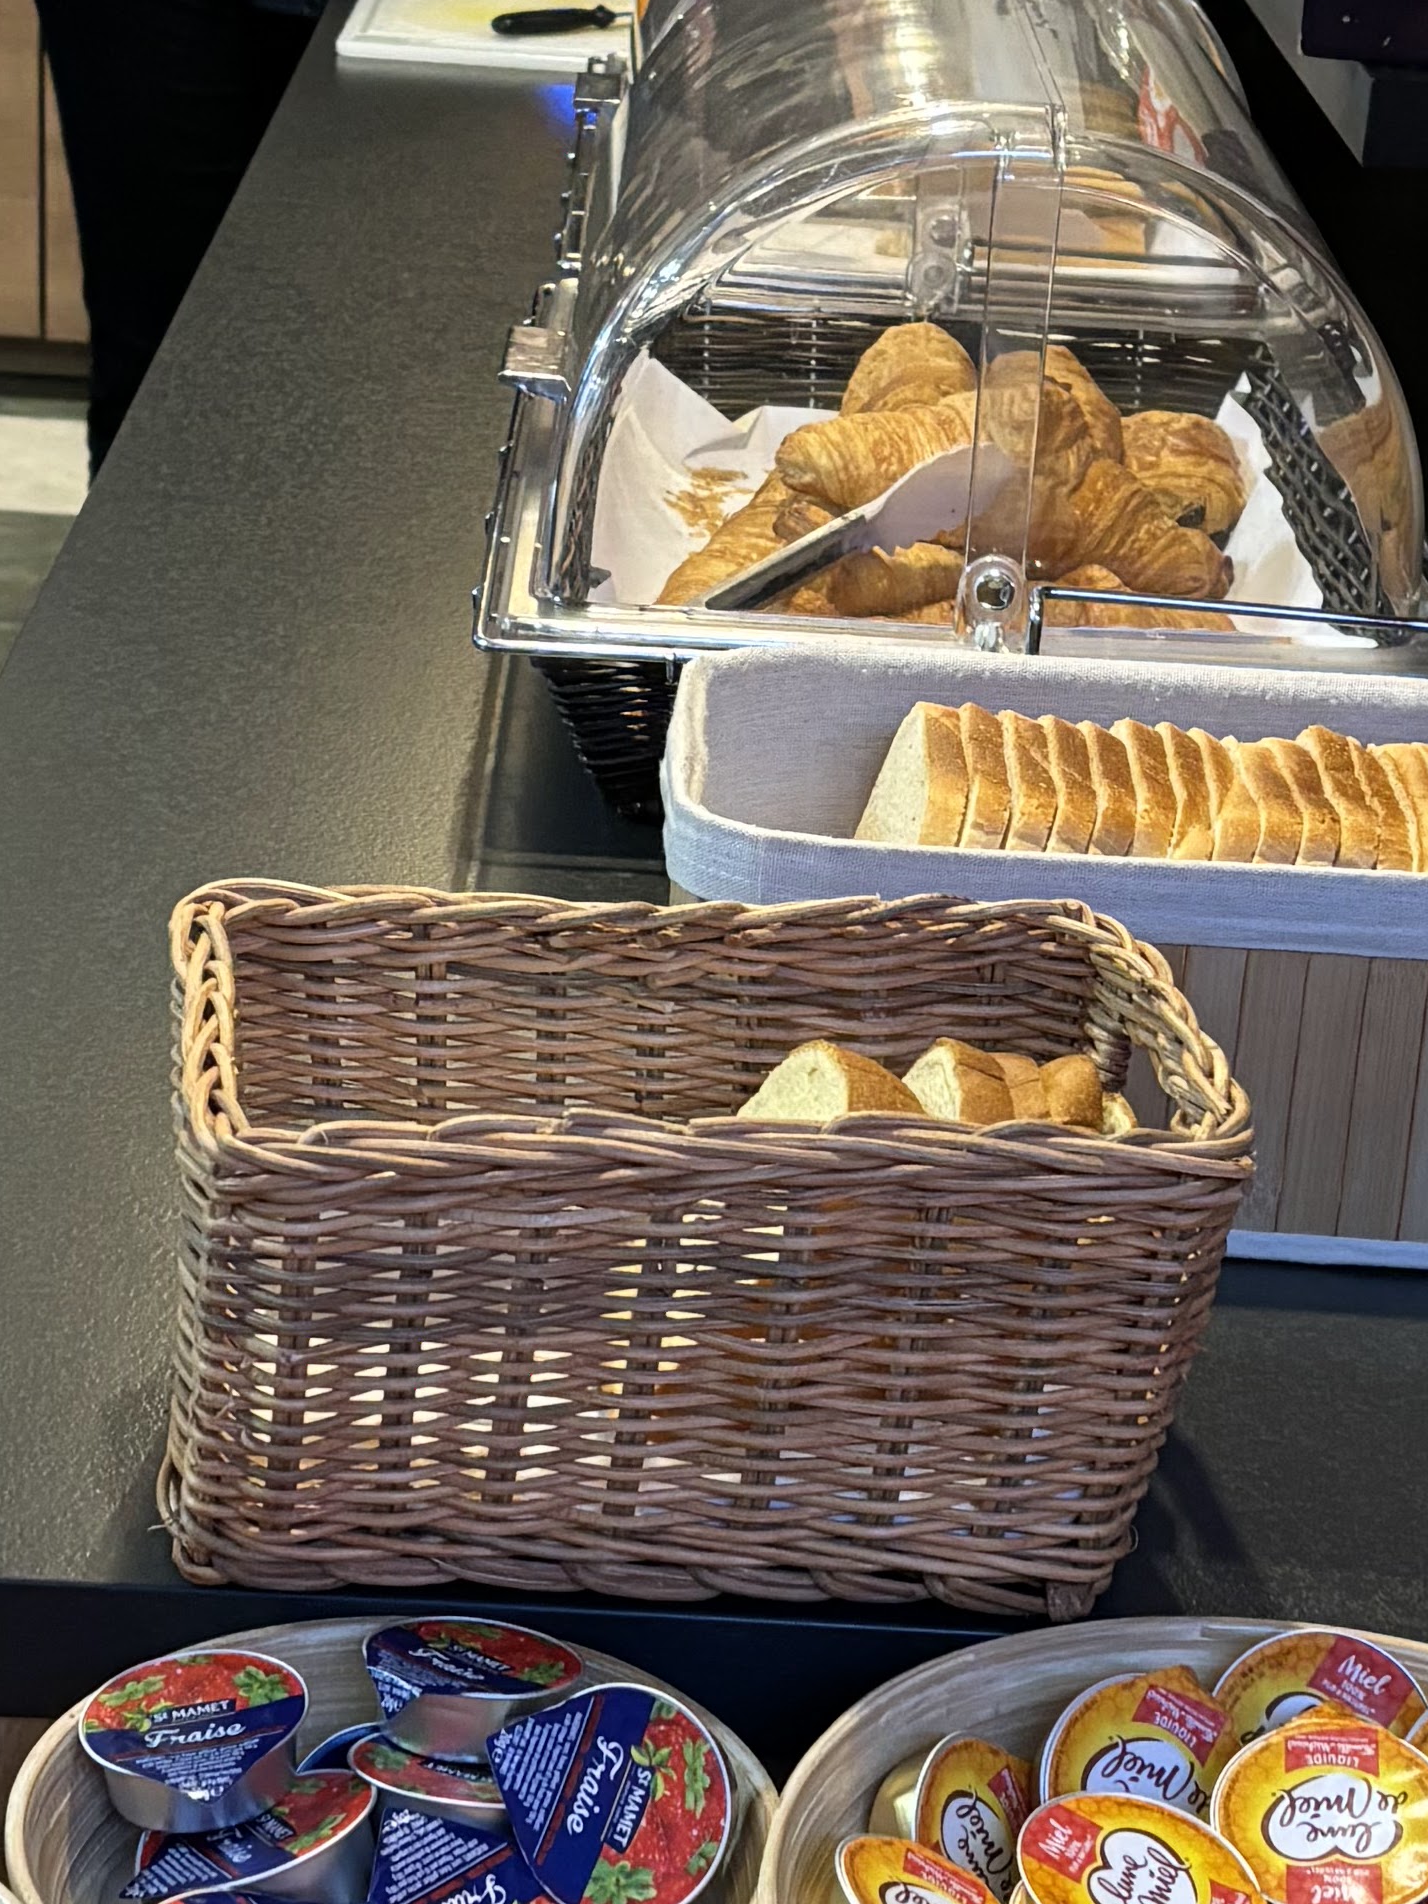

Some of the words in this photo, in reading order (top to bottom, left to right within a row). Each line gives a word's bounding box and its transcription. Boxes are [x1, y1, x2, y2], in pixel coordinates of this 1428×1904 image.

[1337, 1654, 1391, 1695] Miel
[167, 1701, 230, 1720] MAMET
[1154, 1712, 1197, 1748] LIQUIDE
[144, 1723, 246, 1748] Fraise
[1101, 1736, 1194, 1800] Miel
[1305, 1754, 1359, 1768] LIQUIDE
[566, 1735, 624, 1835] Fraise
[1272, 1778, 1373, 1827] Miel
[1377, 1791, 1408, 1814] de
[614, 1785, 650, 1844] MAMET
[956, 1786, 1014, 1875] Miel
[1038, 1818, 1072, 1860] Miel
